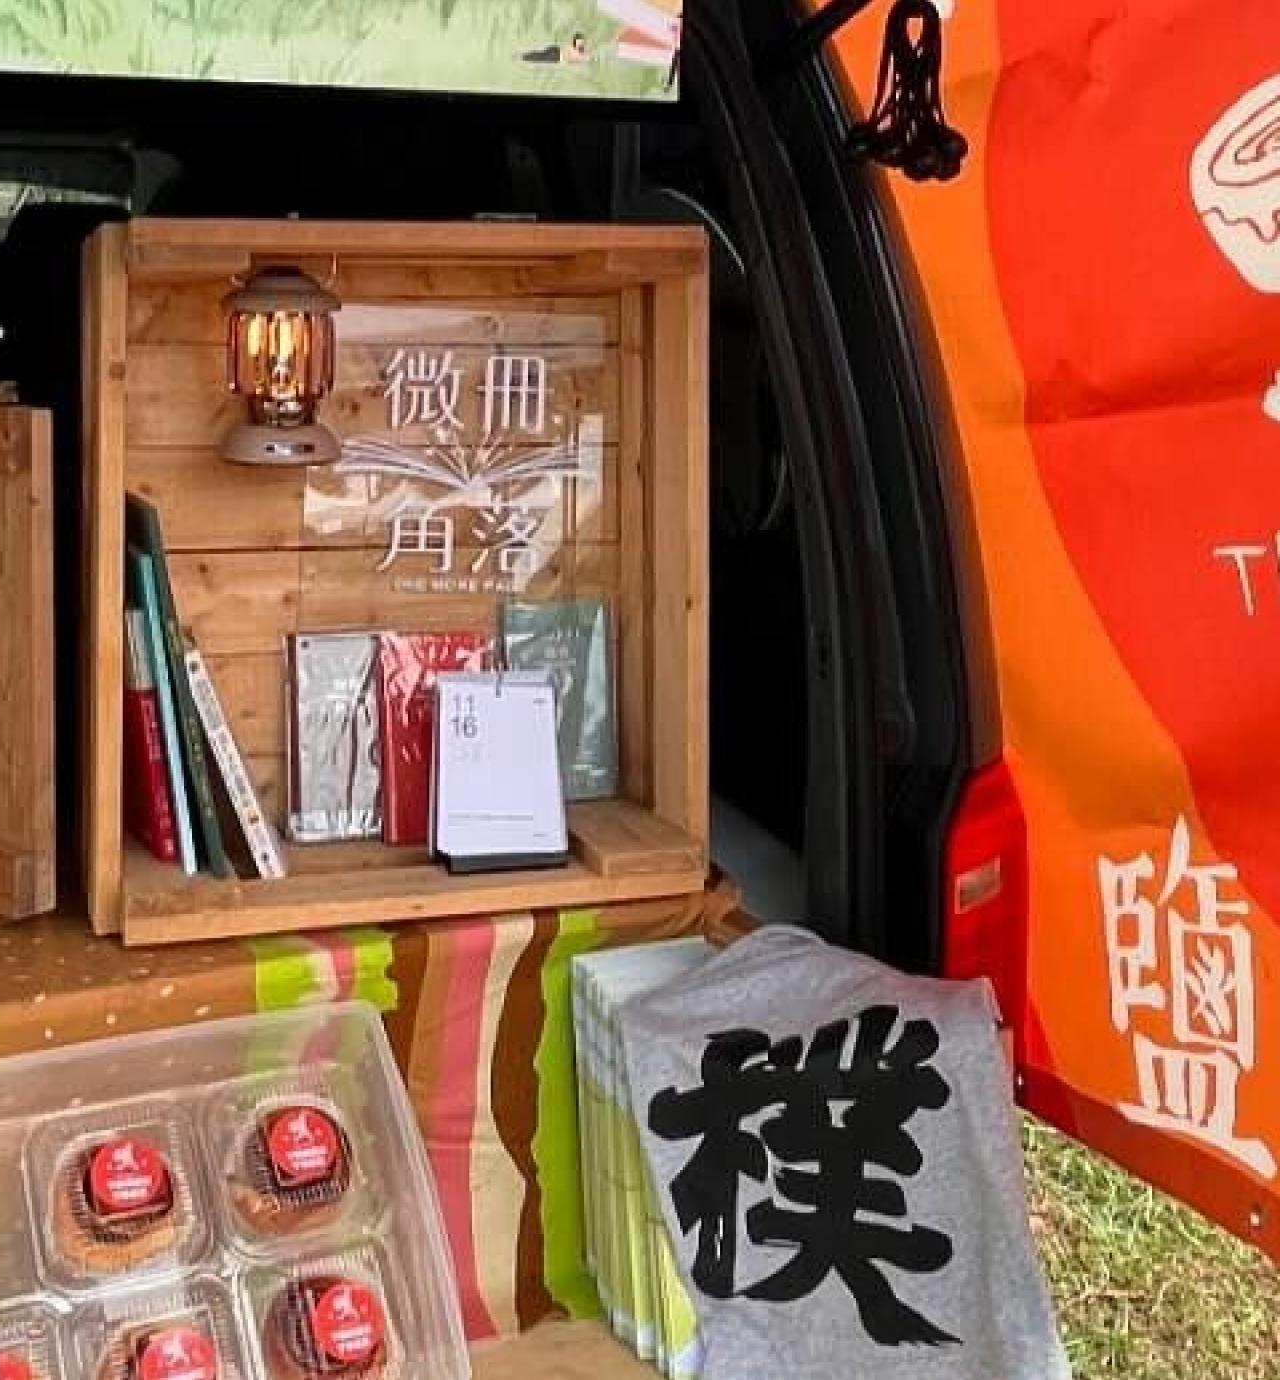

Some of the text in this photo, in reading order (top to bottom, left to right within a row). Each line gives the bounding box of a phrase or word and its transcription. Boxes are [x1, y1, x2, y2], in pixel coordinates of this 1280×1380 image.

[382, 348, 554, 434] 微冊
[375, 493, 546, 574] 角落
[450, 716, 478, 739] 16
